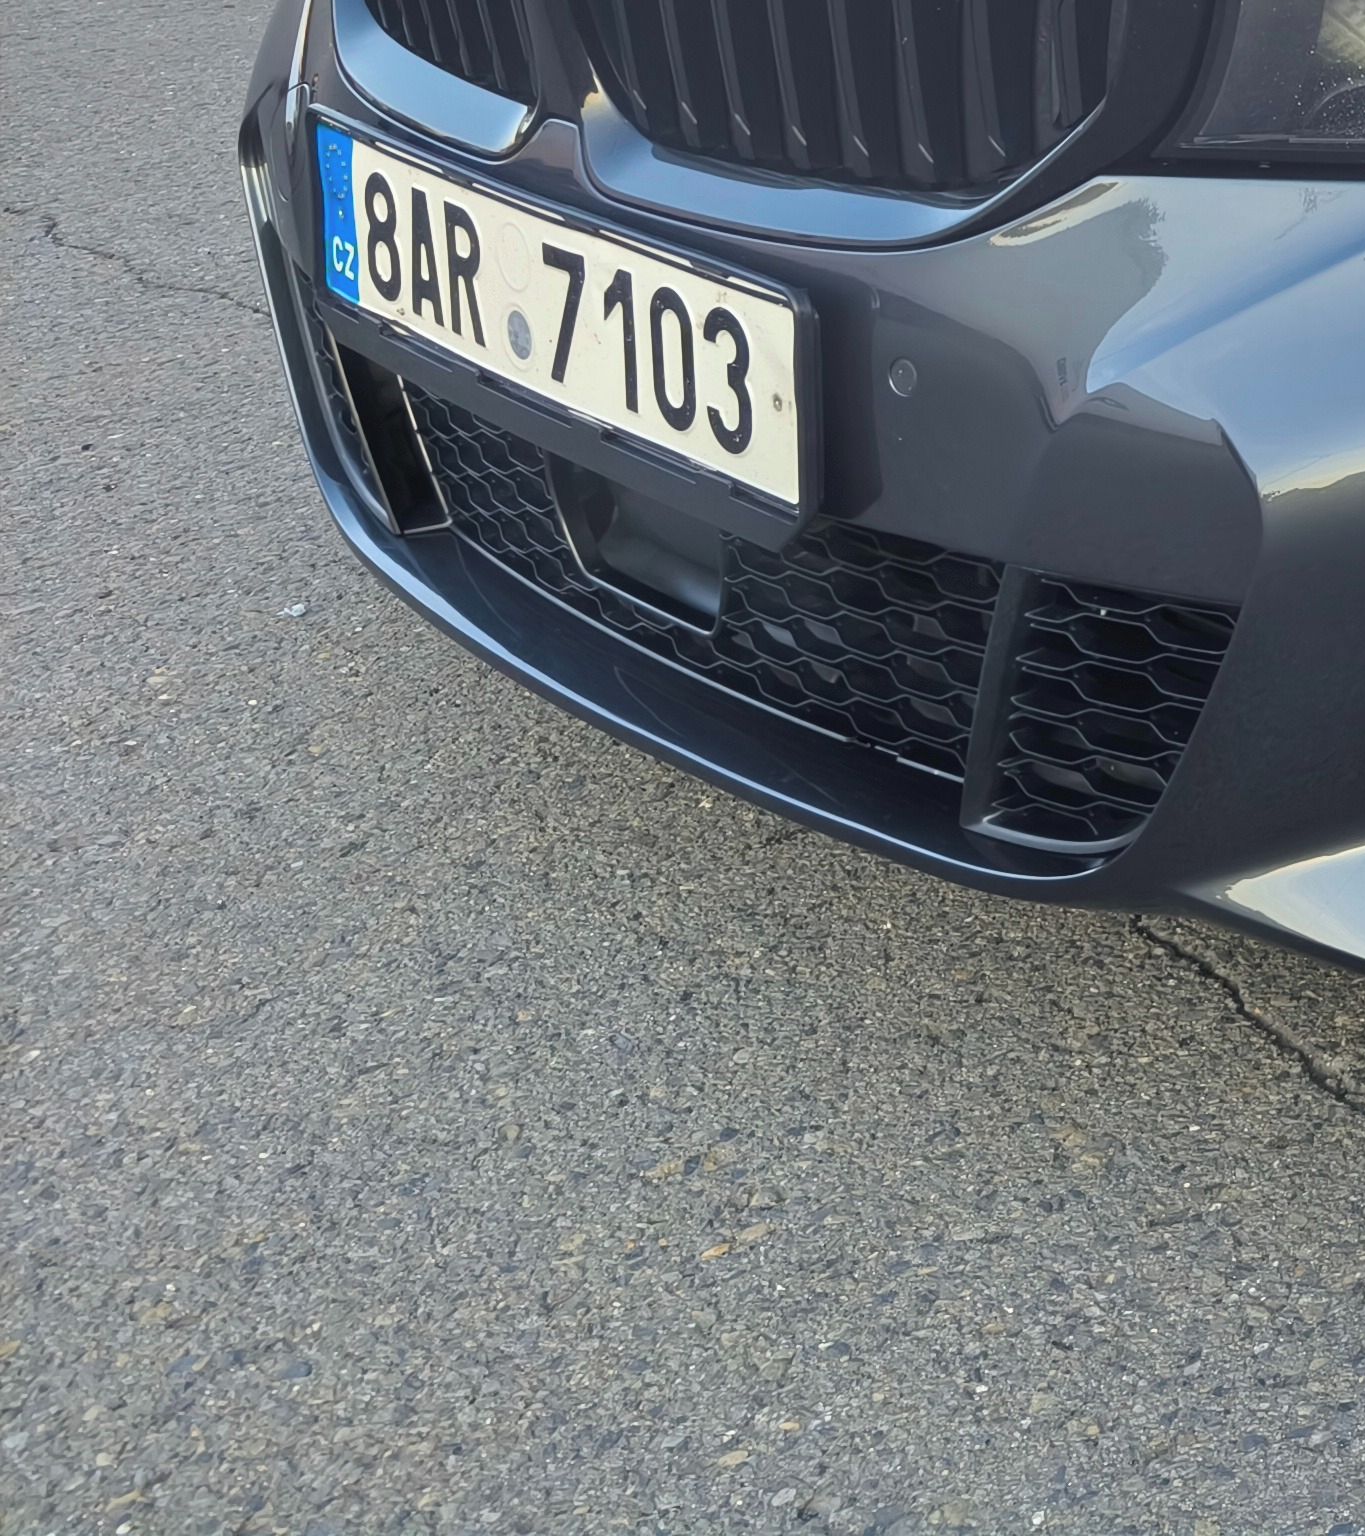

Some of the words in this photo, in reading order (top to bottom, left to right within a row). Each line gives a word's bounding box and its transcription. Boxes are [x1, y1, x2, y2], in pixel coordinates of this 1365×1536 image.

[333, 235, 355, 281] CZ
[364, 171, 487, 348] 8AR
[541, 241, 753, 455] 7103
